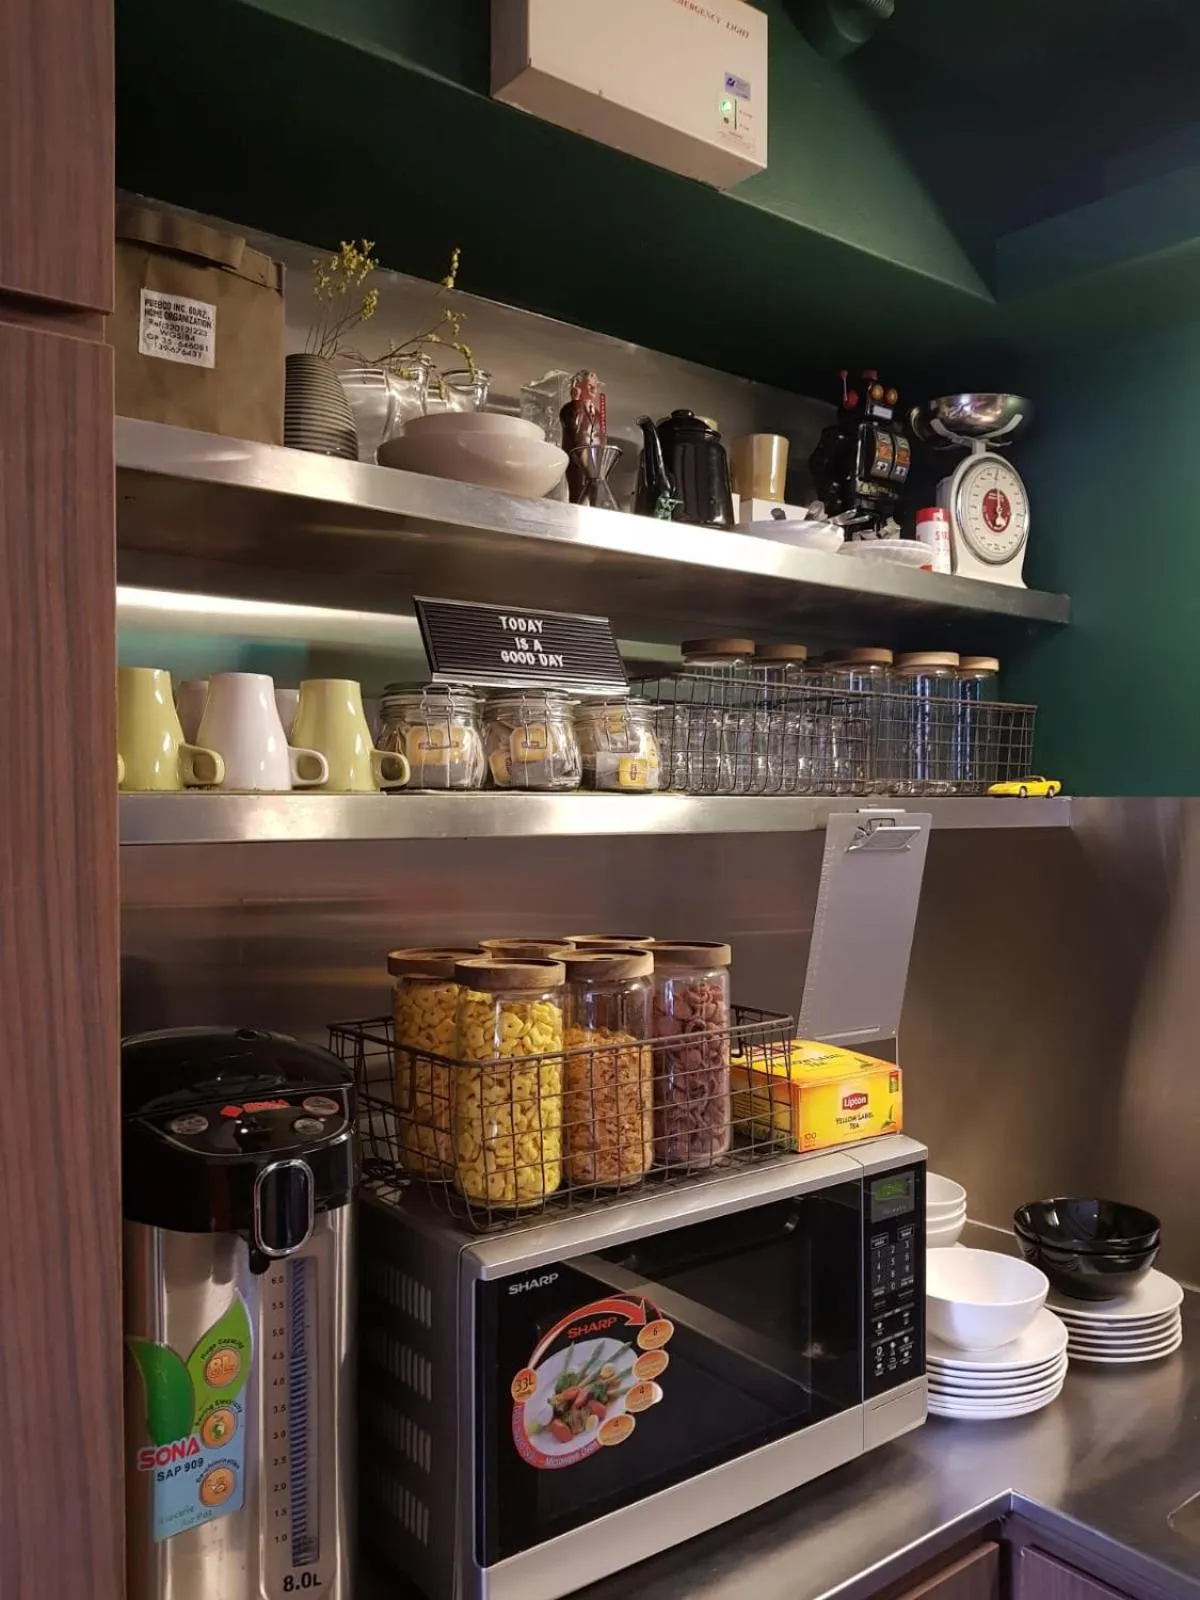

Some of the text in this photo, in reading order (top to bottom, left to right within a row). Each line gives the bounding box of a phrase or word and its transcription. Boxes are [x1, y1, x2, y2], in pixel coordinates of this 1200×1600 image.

[672, 0, 749, 39] MERGENCY LIGHT
[145, 308, 212, 328] HOME ORGANIZATION
[499, 616, 543, 633] TODAY
[514, 637, 543, 652] IS A
[501, 650, 564, 667] GOOD DAY
[844, 1096, 867, 1108] Lipton
[835, 1112, 874, 1125] YELLOW LABEL
[271, 1276, 284, 1285] 6.0
[508, 1272, 559, 1295] SHARP
[272, 1328, 284, 1337] 5.0
[567, 1316, 617, 1339] SHARP
[273, 1377, 285, 1387] 4.0
[273, 1405, 286, 1414] 3.5
[273, 1430, 286, 1440] 3.0
[140, 1437, 200, 1469] SONA
[273, 1456, 287, 1466] 2.5
[157, 1458, 204, 1482] SAP 909
[273, 1483, 287, 1492] 2.0
[274, 1507, 287, 1517] 1.5
[273, 1534, 287, 1543] 1.0
[283, 1571, 322, 1593] 8.0L
